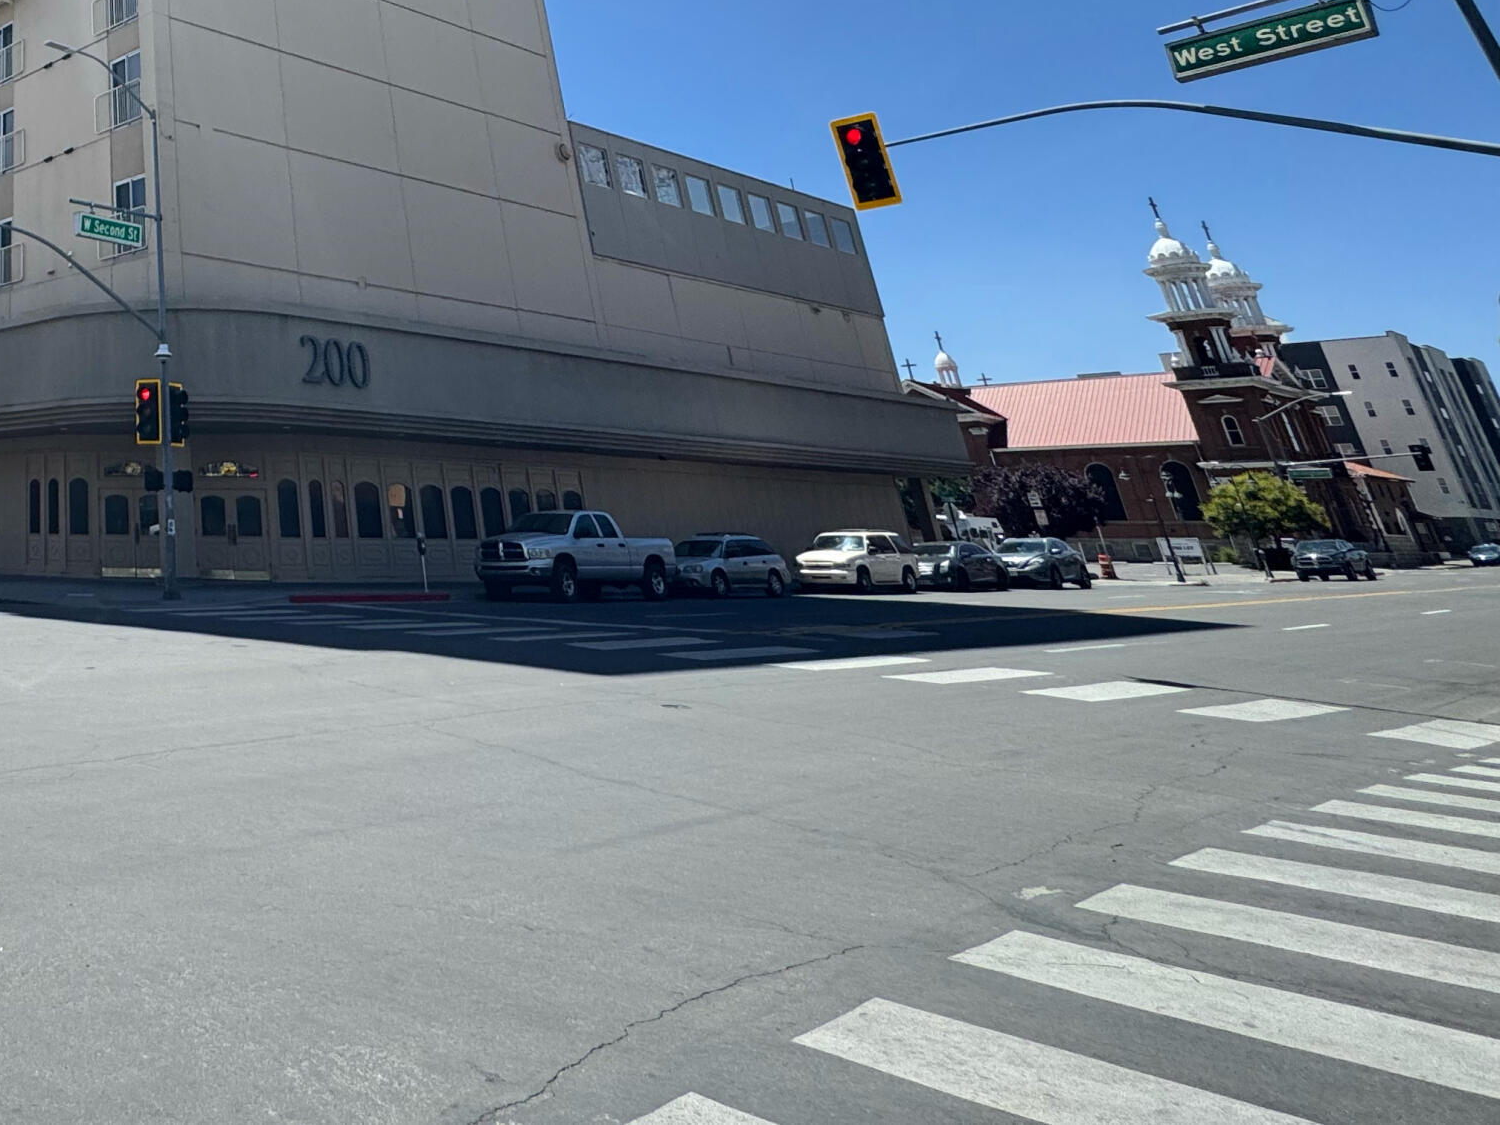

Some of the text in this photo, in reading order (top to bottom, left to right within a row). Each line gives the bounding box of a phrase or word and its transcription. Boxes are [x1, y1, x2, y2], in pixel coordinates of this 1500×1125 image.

[1173, 6, 1360, 66] West Street
[83, 217, 138, 241] W Second St
[300, 335, 370, 388] 200
